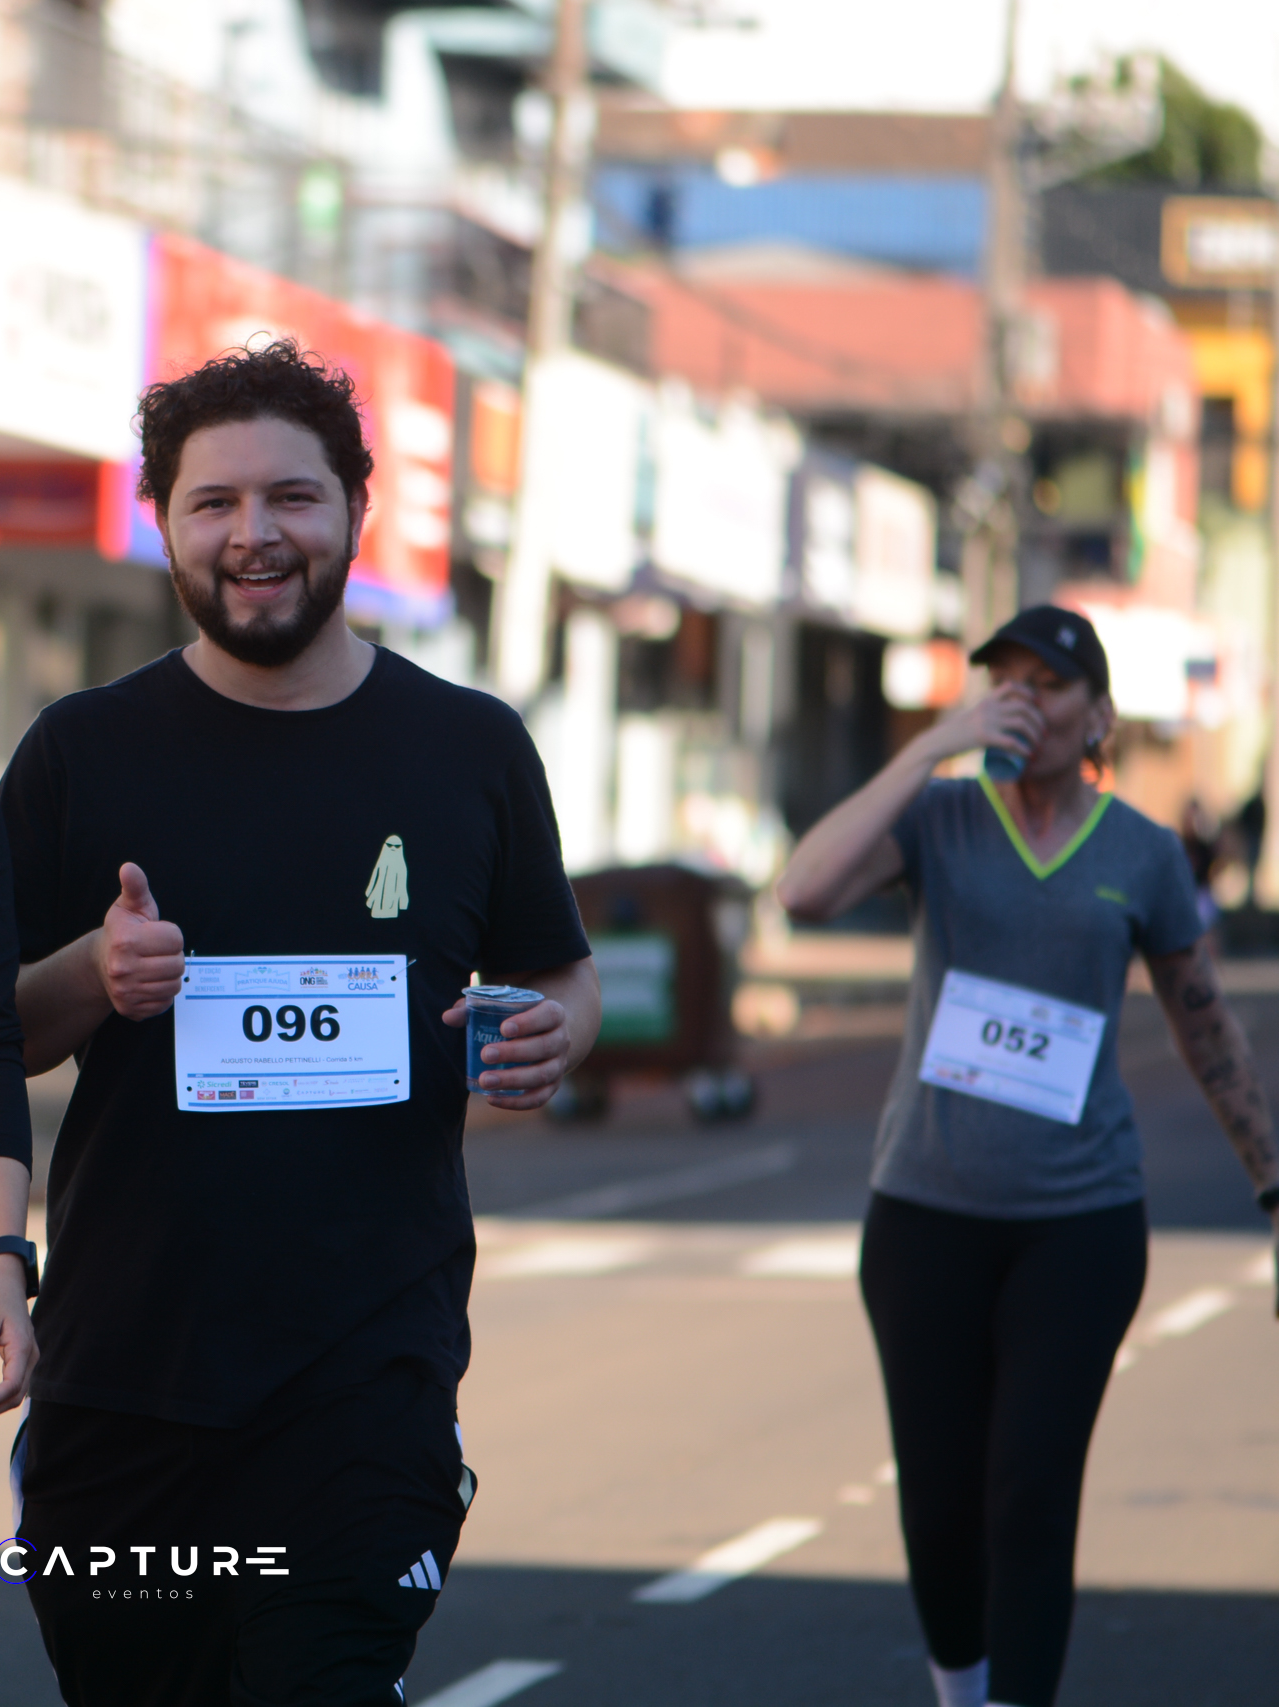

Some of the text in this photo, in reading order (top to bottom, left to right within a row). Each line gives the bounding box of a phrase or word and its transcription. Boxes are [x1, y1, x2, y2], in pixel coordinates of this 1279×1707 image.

[300, 976, 315, 986] ONG
[347, 982, 378, 991] CAUSA
[242, 1004, 341, 1043] 096
[980, 1018, 1051, 1062] 052
